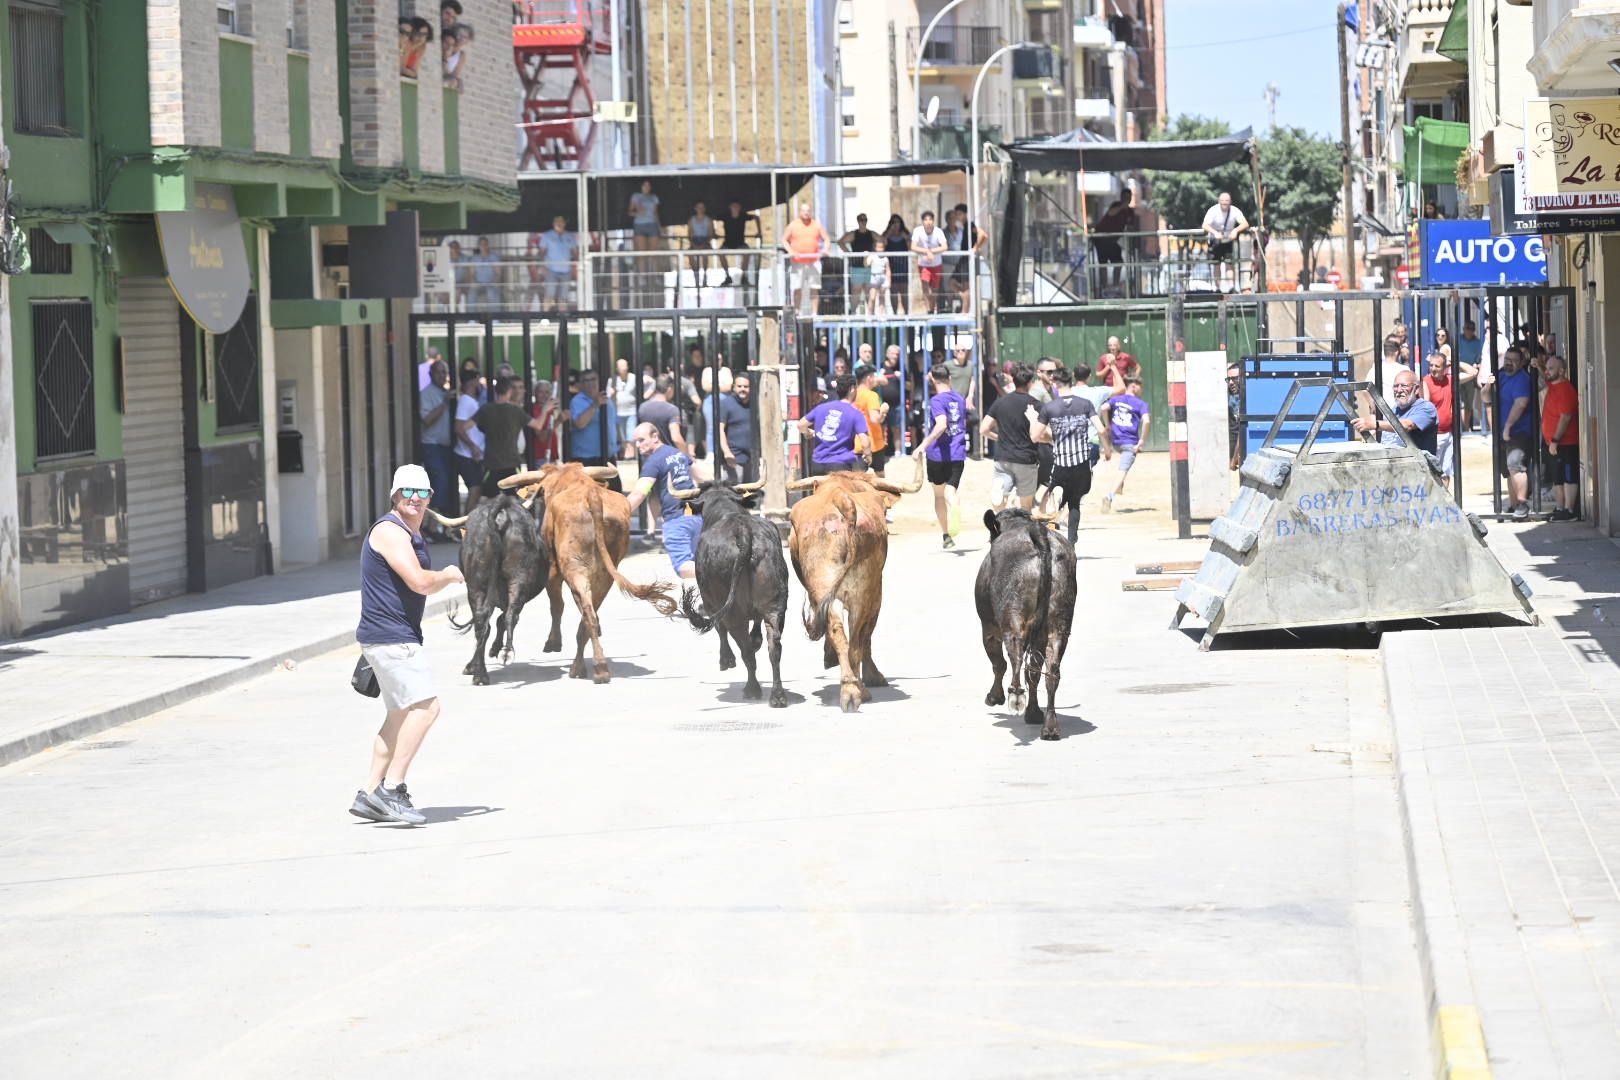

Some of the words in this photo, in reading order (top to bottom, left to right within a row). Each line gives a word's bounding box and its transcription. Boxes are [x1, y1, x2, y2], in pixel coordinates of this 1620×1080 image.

[1561, 155, 1605, 185] La
[1513, 220, 1559, 230] Talleres
[1569, 217, 1616, 229] Propios
[1434, 238, 1516, 263] AUTO
